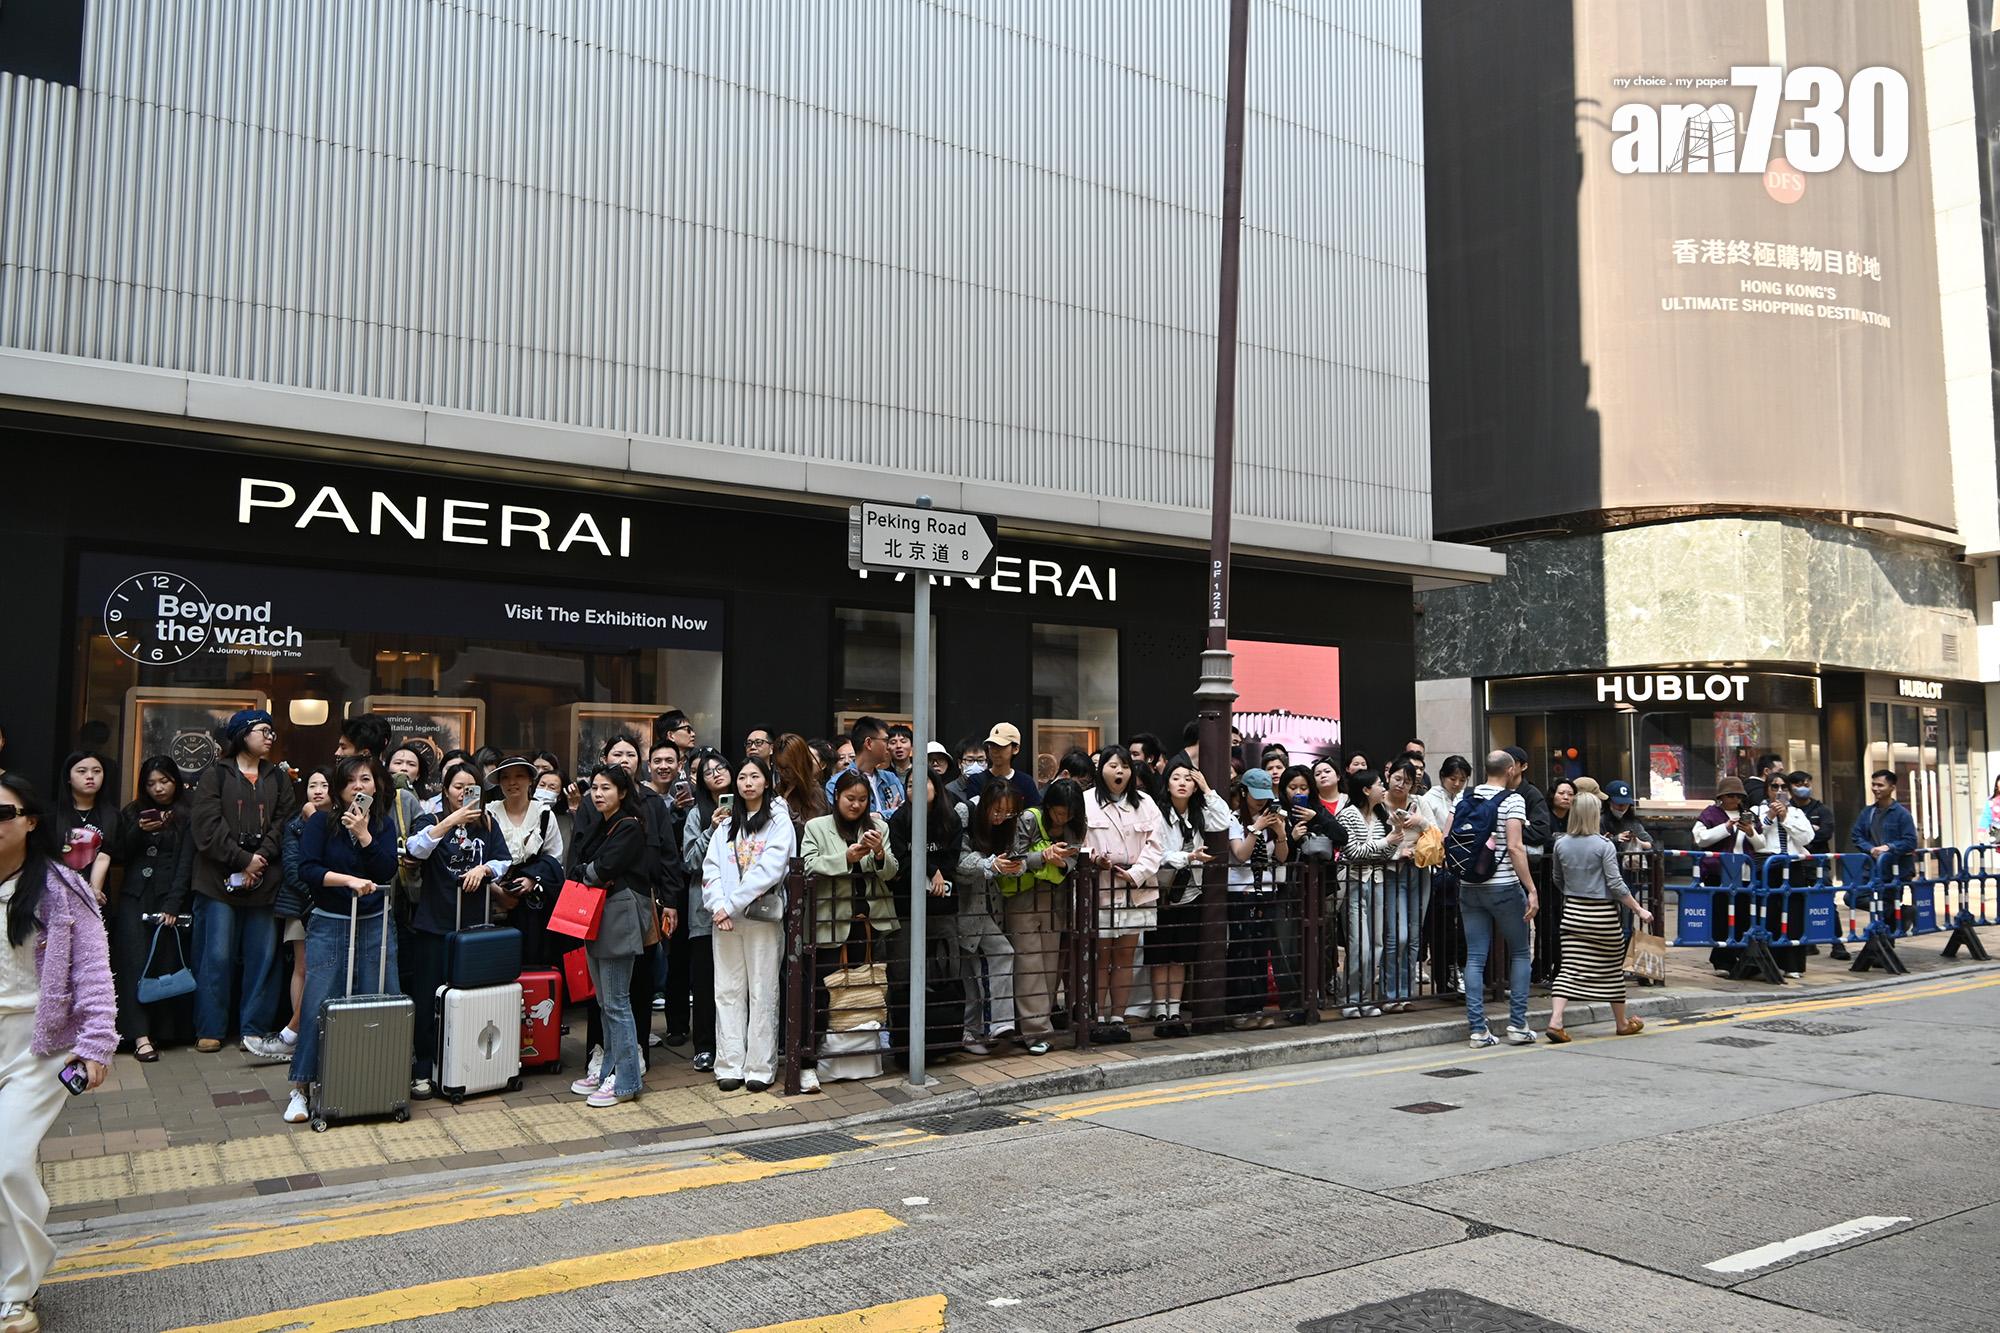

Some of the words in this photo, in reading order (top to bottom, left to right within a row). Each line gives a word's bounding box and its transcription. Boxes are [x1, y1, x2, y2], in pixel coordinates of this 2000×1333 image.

[1767, 171, 1802, 192] DFS
[1672, 238, 1882, 282] 香港終極購物目的地
[1740, 279, 1782, 295] HONG
[1785, 283, 1837, 300] KONG'S
[1661, 297, 1739, 311] ULTIMATE
[1742, 299, 1814, 317] SHOPPING
[1817, 305, 1891, 328] DESTINATION
[238, 477, 631, 558] PANERAI
[867, 511, 920, 534] Peking
[927, 518, 967, 536] Road
[884, 538, 950, 564] 北京道
[961, 550, 969, 561] 8
[152, 576, 170, 589] 12
[859, 556, 1117, 601] ERAI
[158, 594, 272, 623] Beyond
[1213, 582, 1221, 618] 1221
[109, 609, 122, 622] 9
[504, 603, 543, 620] Visit
[547, 606, 580, 623] The
[585, 609, 667, 628] Exhibition
[672, 615, 708, 631] Now
[156, 619, 205, 642] the
[214, 626, 303, 647] watch
[152, 648, 164, 660] 6
[216, 647, 247, 656] Journey
[250, 648, 282, 658] Through
[283, 650, 302, 658] Time
[1597, 674, 1750, 702] HUBLOT
[1899, 679, 1944, 700] HUBLOT
[415, 725, 440, 733] legend
[1619, 786, 1628, 796] C
[1684, 908, 1706, 916] POLICE
[1808, 907, 1829, 915] POLICE
